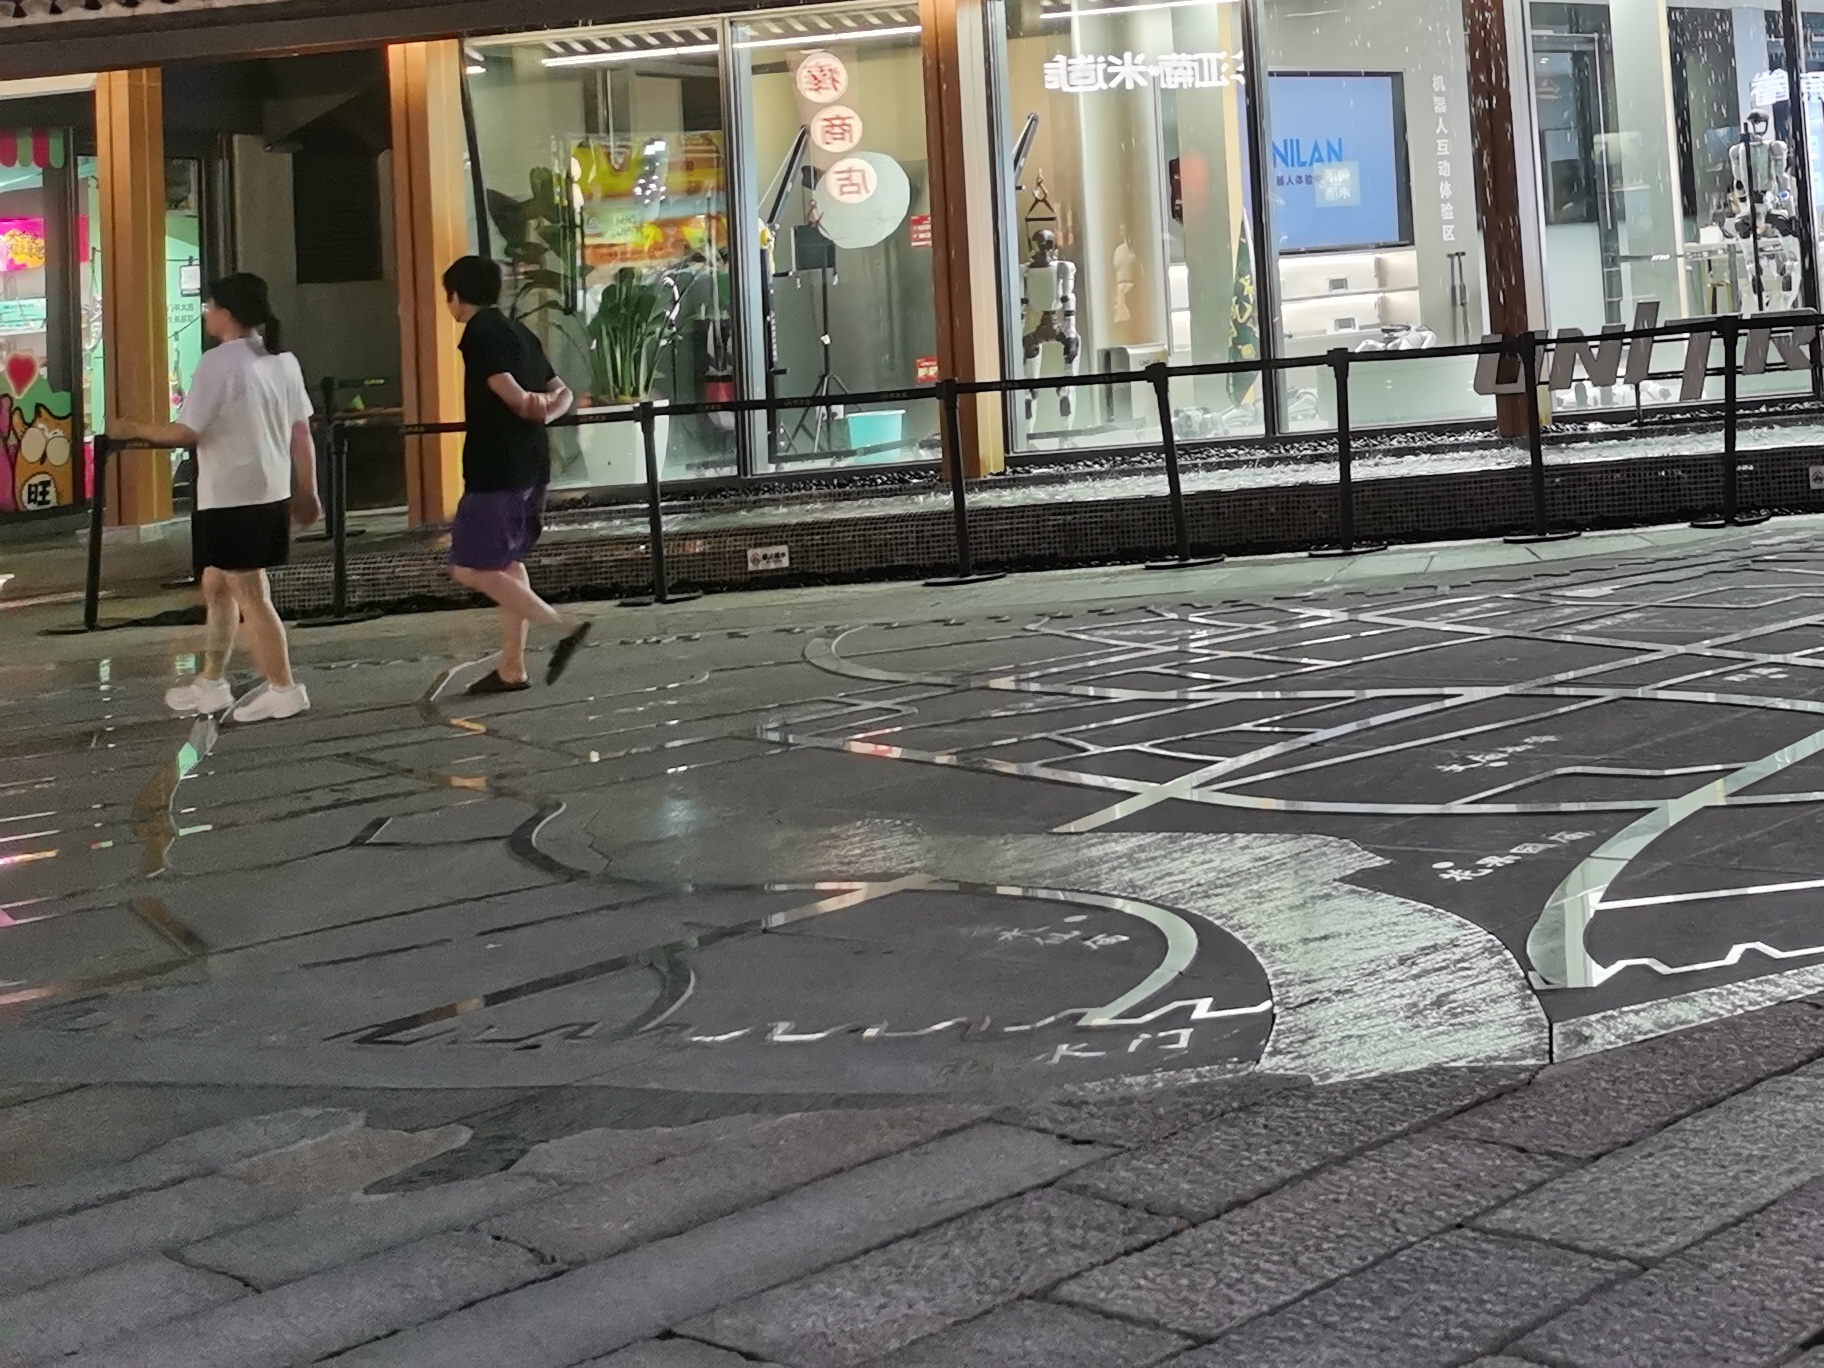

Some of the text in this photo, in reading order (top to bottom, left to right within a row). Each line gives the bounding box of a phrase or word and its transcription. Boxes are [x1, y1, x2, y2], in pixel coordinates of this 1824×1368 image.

[1432, 74, 1456, 241] 机器人互动体验区
[28, 480, 51, 506] 旺
